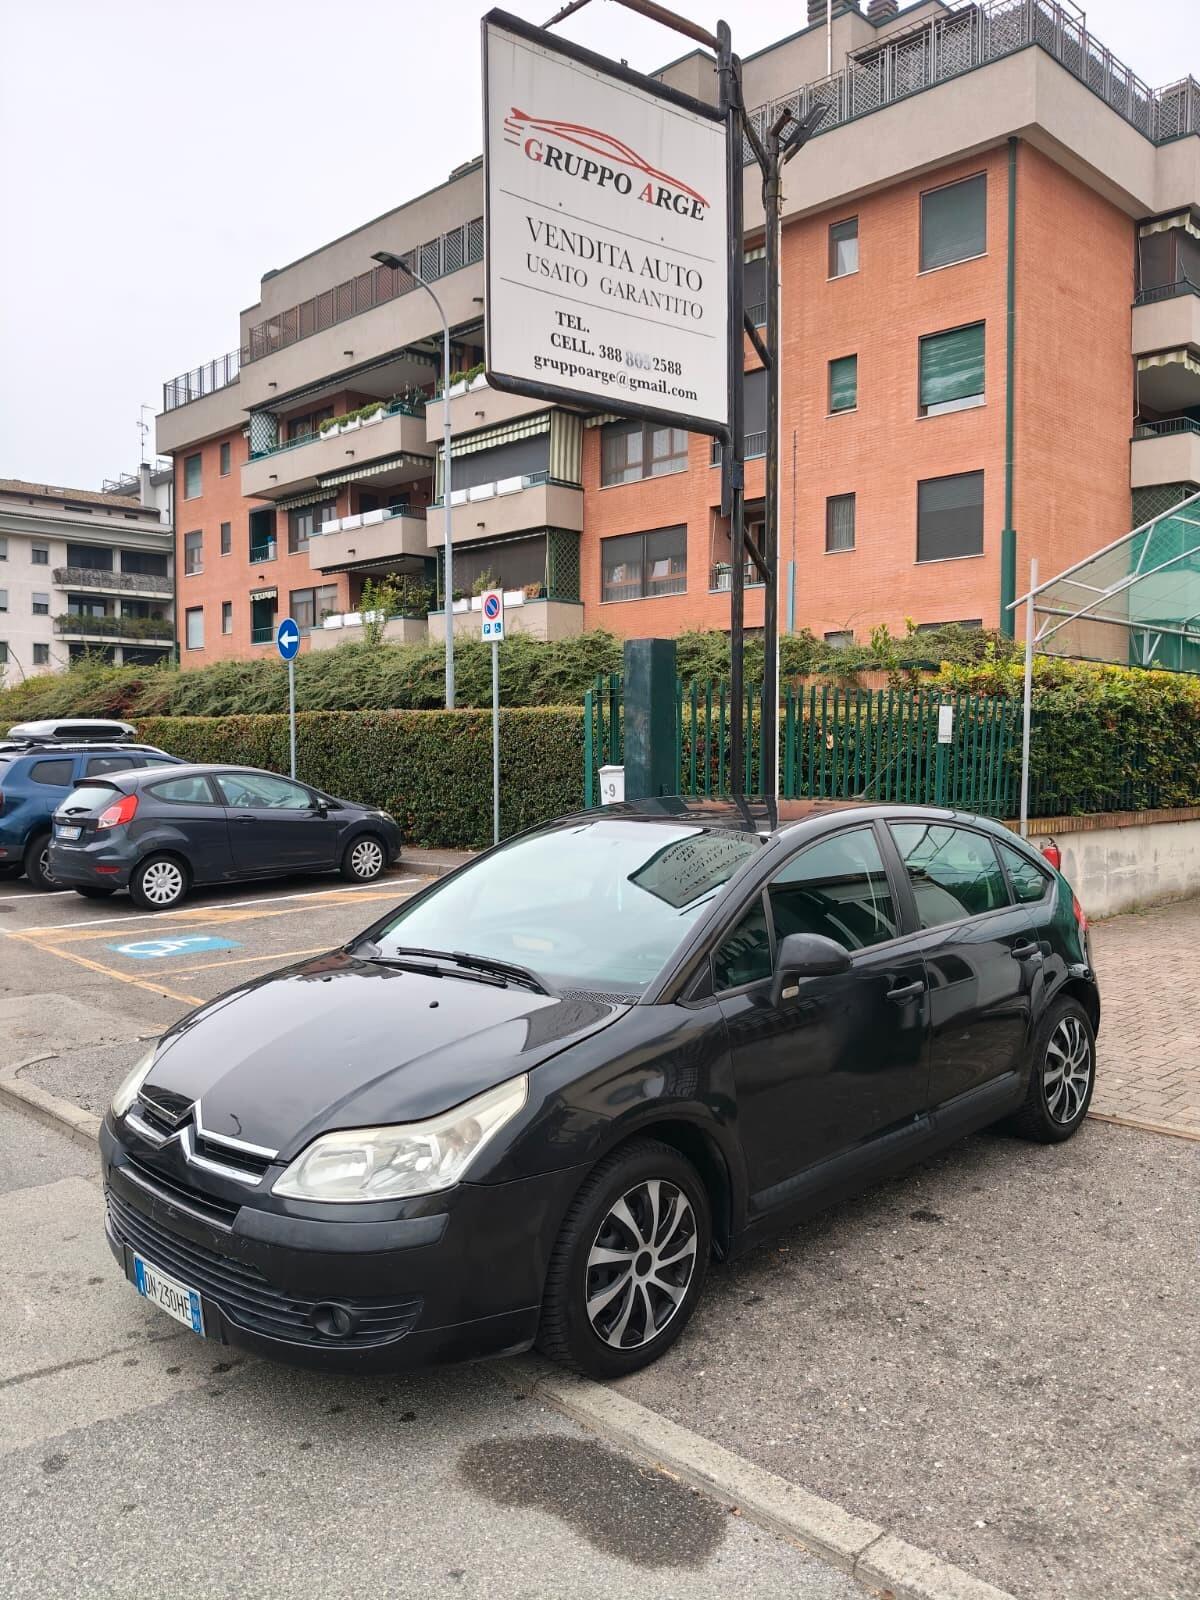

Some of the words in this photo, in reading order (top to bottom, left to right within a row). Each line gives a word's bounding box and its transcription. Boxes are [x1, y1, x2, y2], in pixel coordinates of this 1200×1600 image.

[525, 139, 632, 194] GRUPPO
[638, 183, 705, 221] ARGE
[526, 217, 633, 273] VENDITA
[641, 256, 703, 292] AUTO
[527, 254, 588, 287] USATO
[600, 277, 703, 320] GARANTITO
[555, 311, 590, 333] TEL.
[534, 354, 698, 401] gruppoarge@gmail.com
[551, 333, 595, 356] CELL.
[599, 344, 622, 363] 388
[652, 357, 682, 376] 2588
[609, 783, 616, 798] 9
